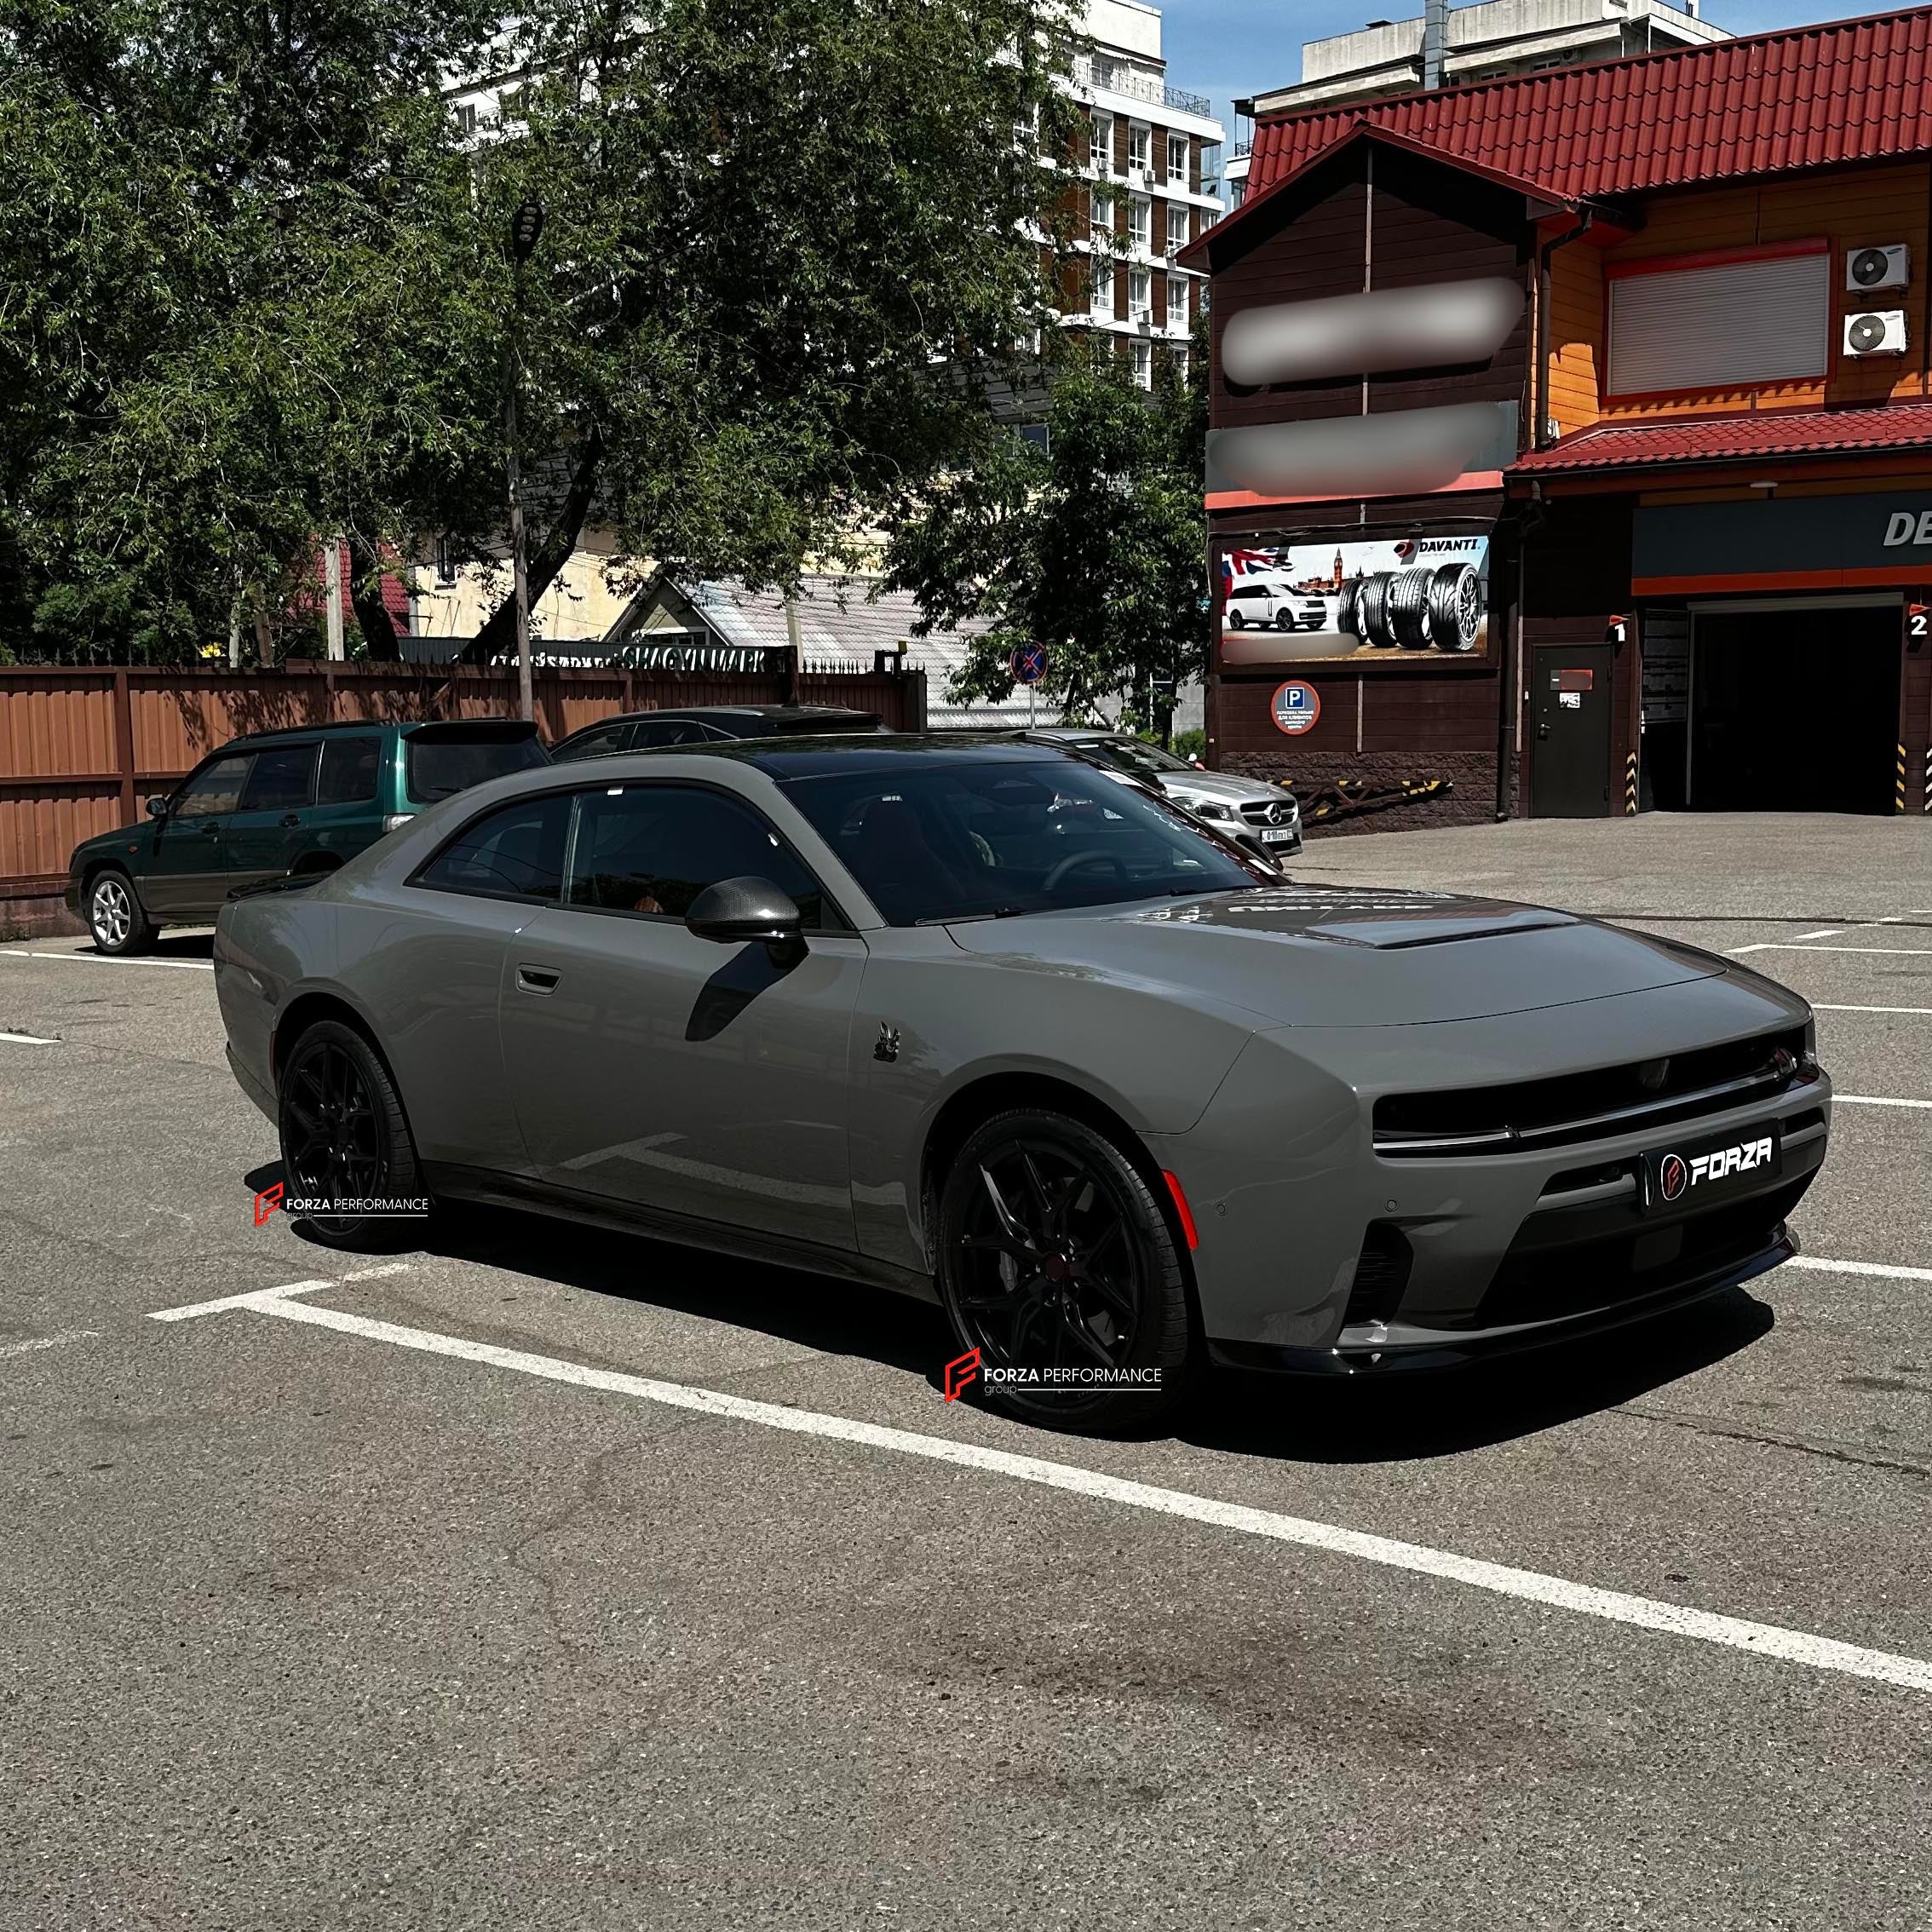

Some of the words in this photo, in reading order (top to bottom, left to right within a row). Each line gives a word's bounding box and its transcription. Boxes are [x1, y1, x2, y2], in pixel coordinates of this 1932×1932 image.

[1883, 510, 1932, 546] DE
[1418, 538, 1478, 553] DAVANTI
[1614, 624, 1625, 641] 1
[1911, 615, 1928, 635] 2
[1289, 690, 1301, 706] P
[1689, 1136, 1773, 1186] FORZA
